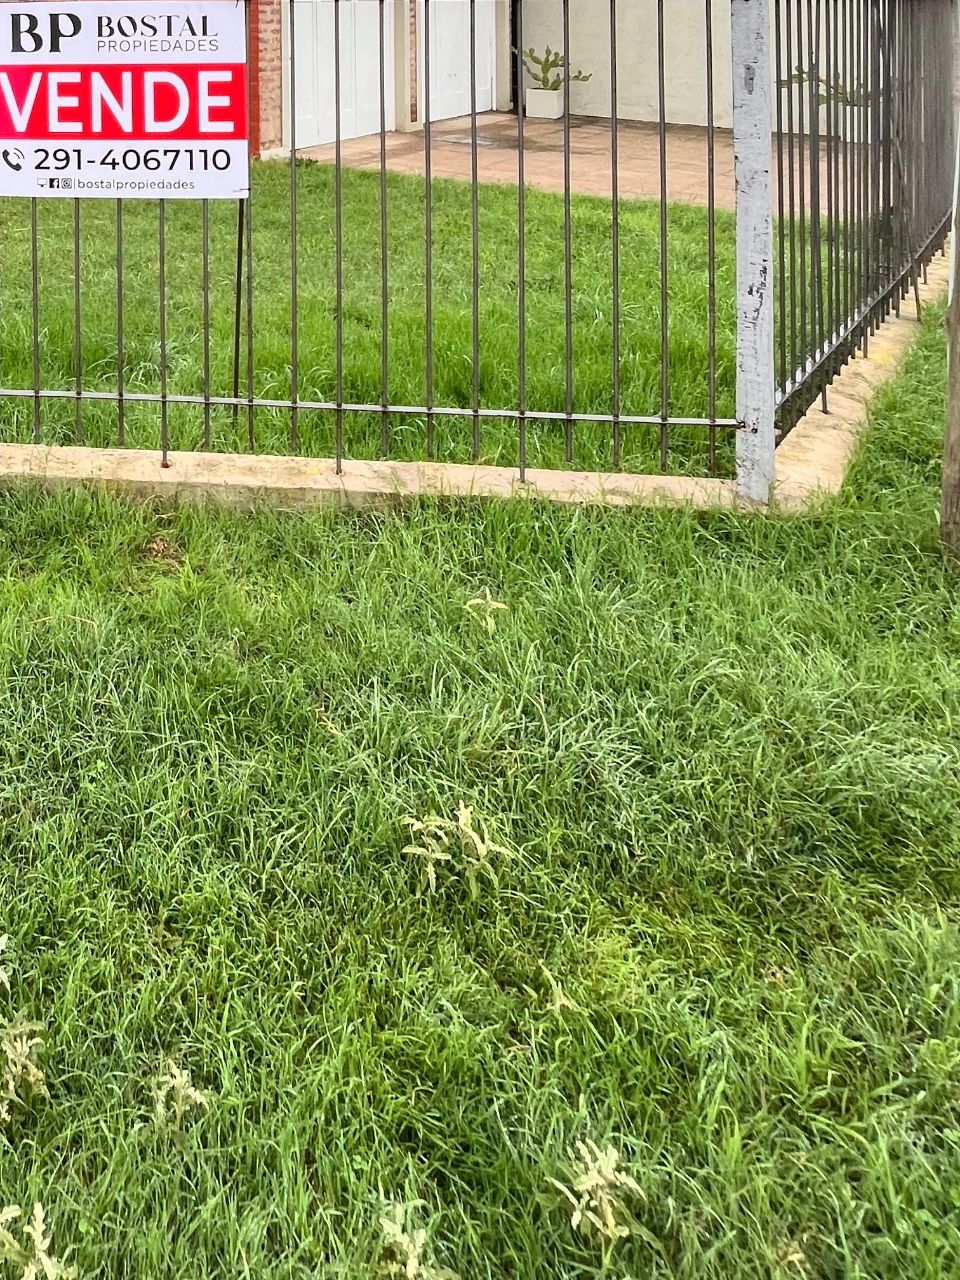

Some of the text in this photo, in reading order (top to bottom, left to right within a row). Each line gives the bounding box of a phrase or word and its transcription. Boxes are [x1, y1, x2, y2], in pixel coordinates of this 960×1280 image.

[11, 13, 82, 53] BP
[97, 15, 218, 38] BOSTAL
[97, 39, 219, 52] PROPIEDADES
[33, 148, 231, 171] 291-4067110
[77, 178, 195, 191] bostalpropiedades
